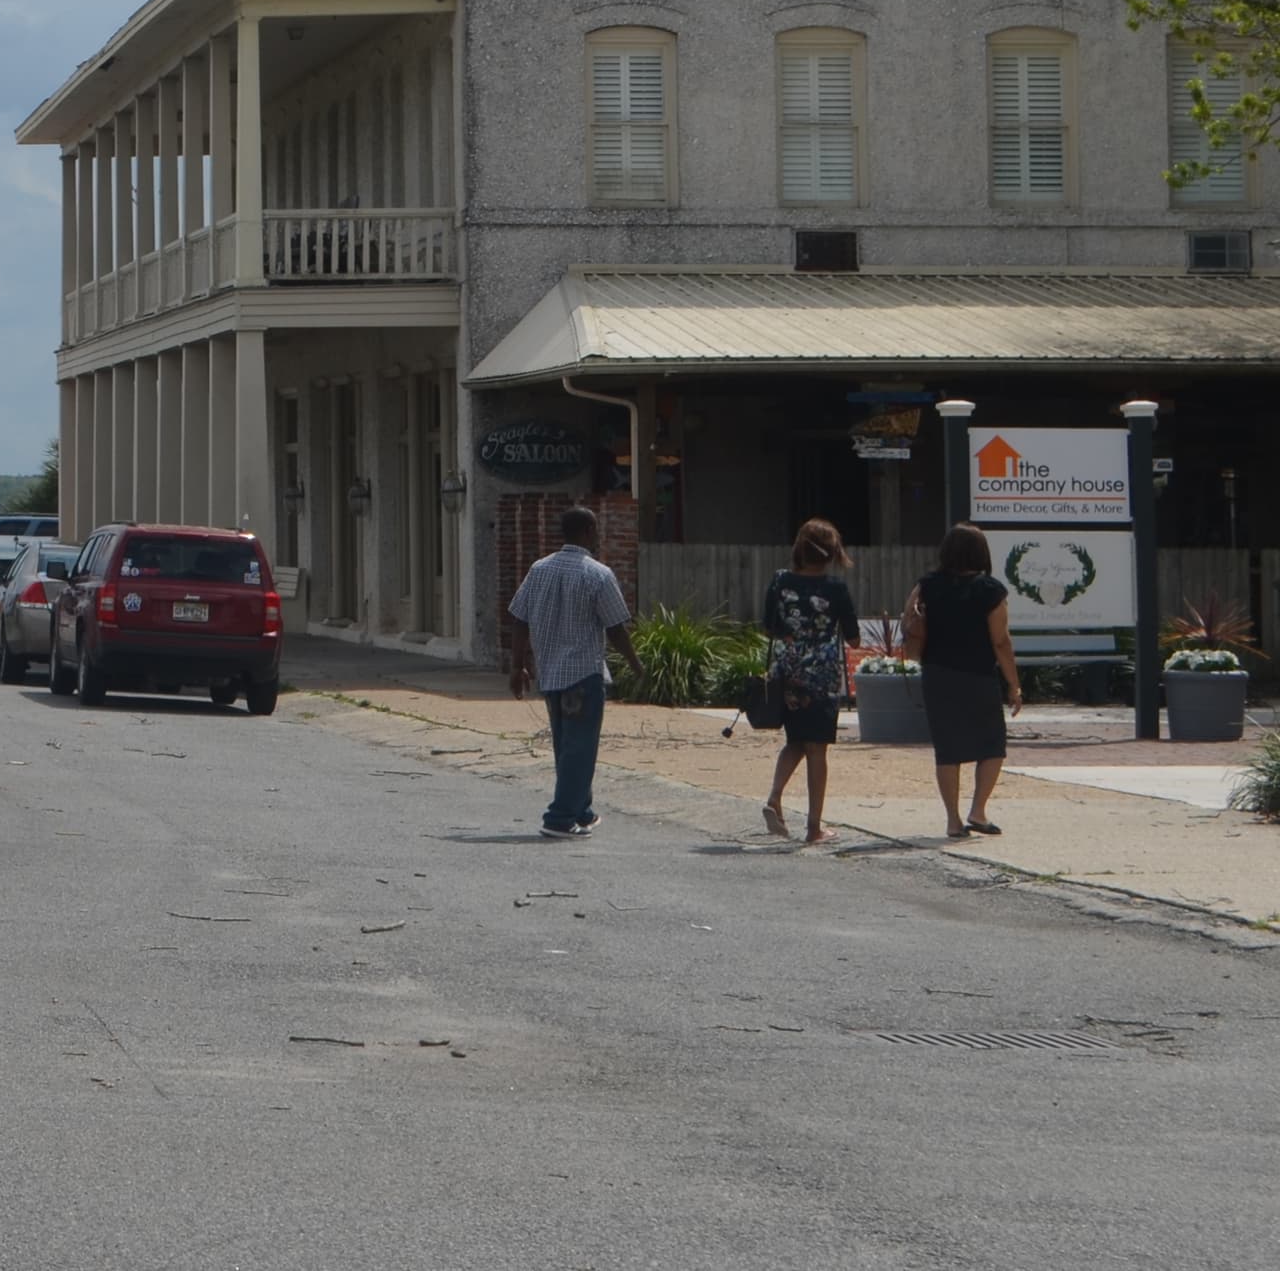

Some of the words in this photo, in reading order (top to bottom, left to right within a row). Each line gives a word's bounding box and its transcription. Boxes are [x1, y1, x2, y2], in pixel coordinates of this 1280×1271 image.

[503, 443, 583, 464] SALOON
[1018, 461, 1050, 478] the
[978, 477, 1066, 495] company
[1071, 476, 1125, 493] house
[976, 502, 1010, 513] Home
[1051, 502, 1077, 514] Gifts,
[1081, 503, 1090, 513] &
[1094, 503, 1123, 514] More
